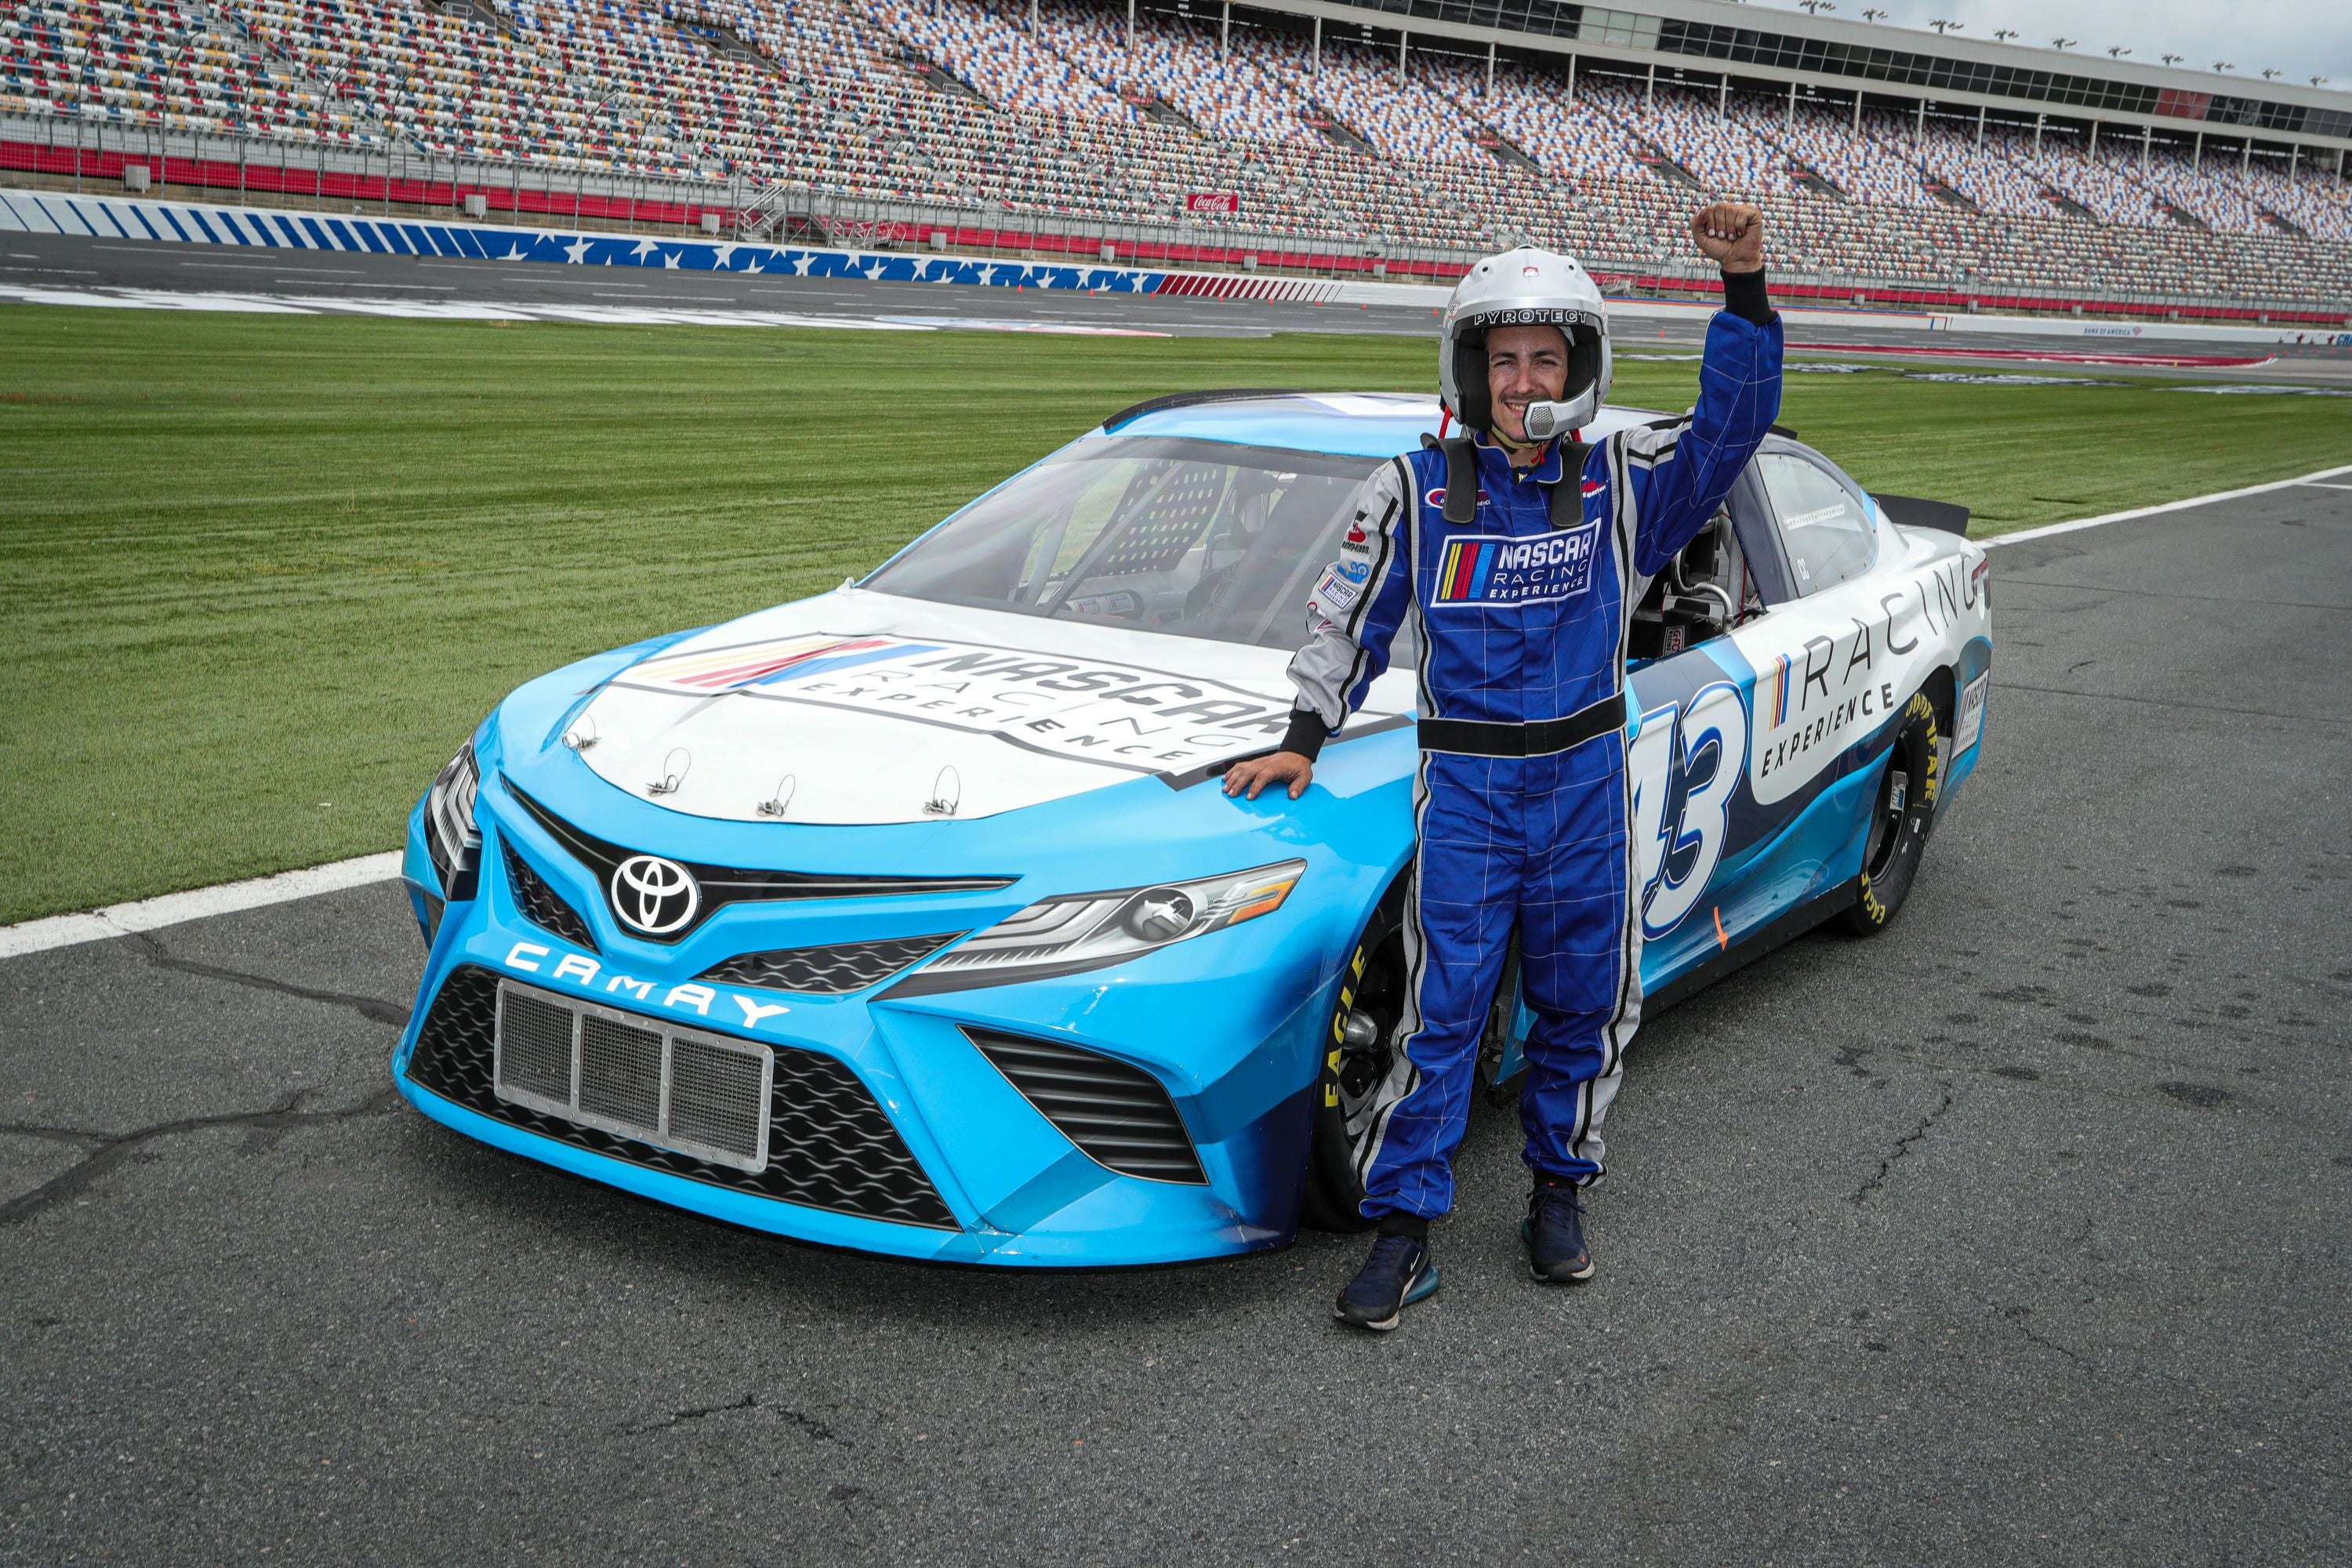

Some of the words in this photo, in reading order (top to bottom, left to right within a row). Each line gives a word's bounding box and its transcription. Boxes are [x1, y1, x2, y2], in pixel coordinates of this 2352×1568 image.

[1474, 309, 1588, 325] PYROTECT
[1493, 559, 1588, 585] RACING
[1498, 531, 1592, 570] NASCAR
[1332, 581, 1354, 599] NASCAR
[1490, 575, 1584, 599] EXPERIENCE
[1800, 551, 1976, 711] RACING
[800, 683, 1195, 760] EXPERIENCE
[851, 670, 1250, 747] RACING
[1762, 682, 1893, 779] EXPERIENCE
[1325, 945, 1367, 1107] EAGLE
